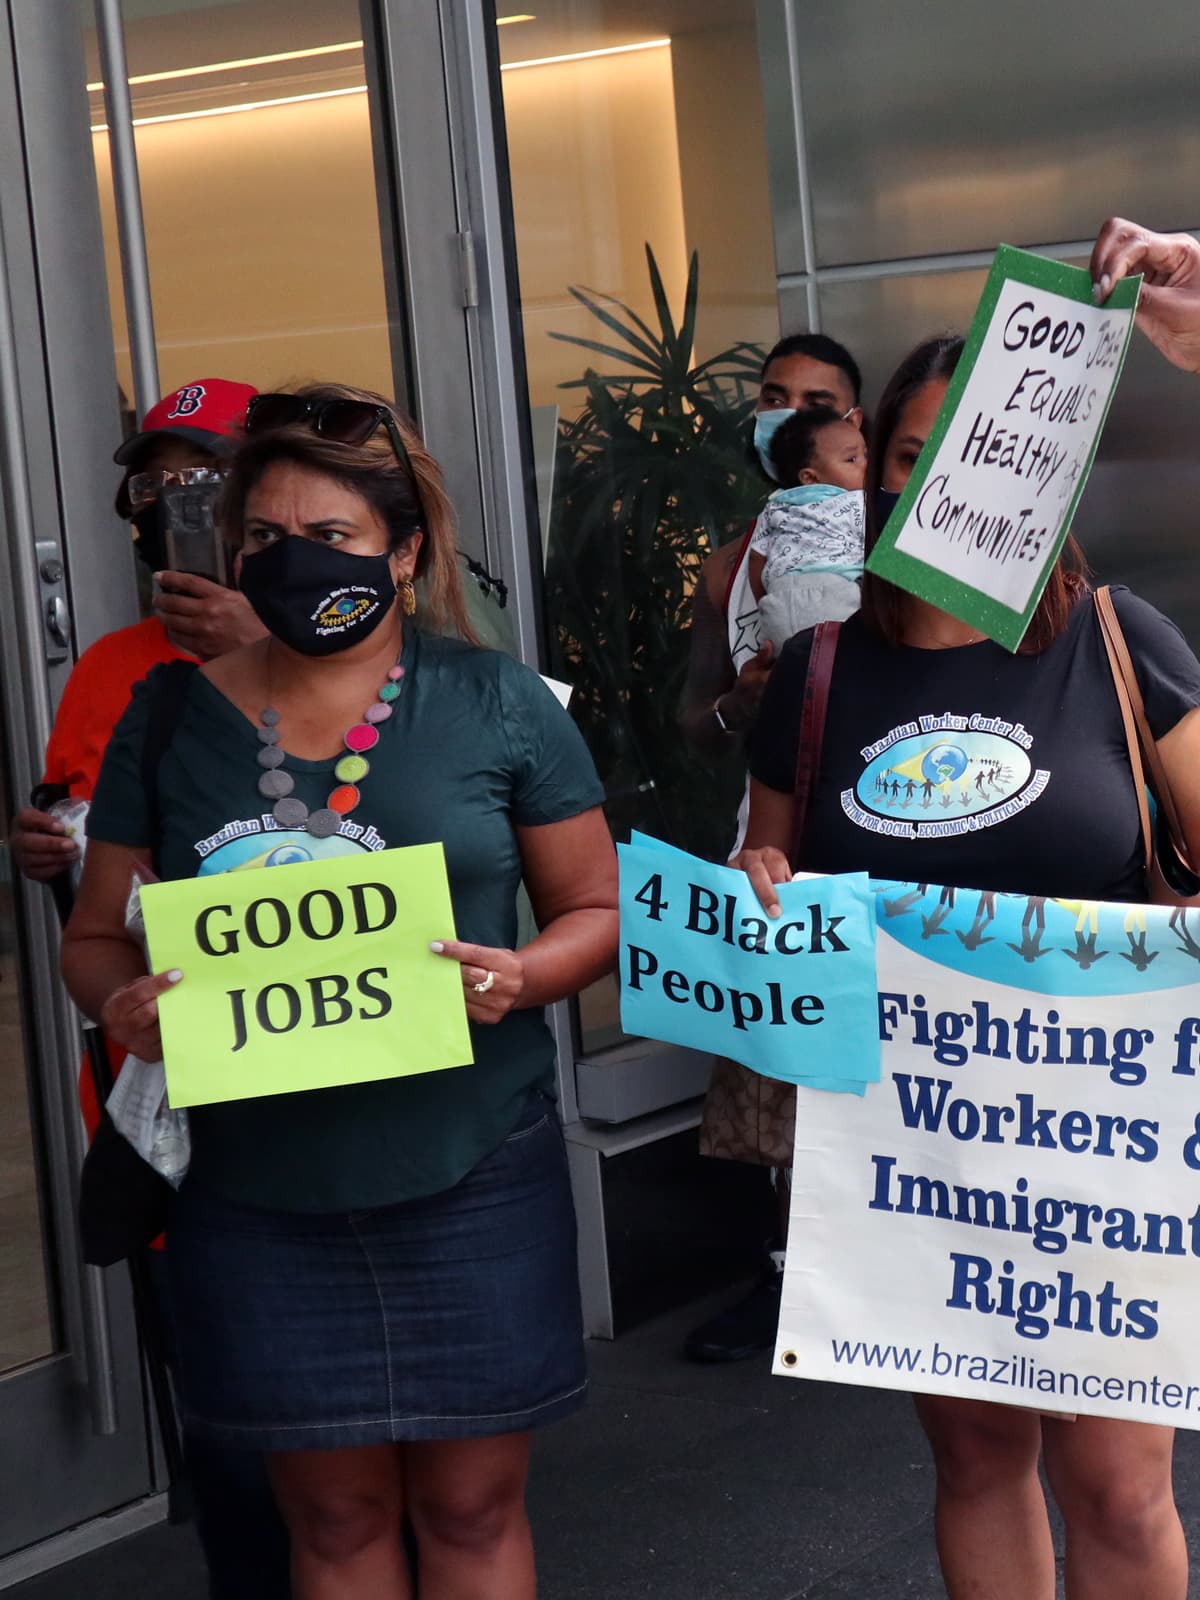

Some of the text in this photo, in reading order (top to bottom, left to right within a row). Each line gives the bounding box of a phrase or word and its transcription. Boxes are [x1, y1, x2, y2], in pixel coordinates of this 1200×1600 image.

[1003, 301, 1125, 369] GOOD JO
[168, 385, 206, 418] B
[1004, 368, 1097, 425] EQUALS
[860, 712, 1033, 762] Brazilian Worker Center Inc.
[195, 819, 260, 856] Brazilian
[862, 816, 880, 834] FOR
[878, 820, 917, 840] SOCIAL,
[917, 819, 969, 838] ECONOMIC
[967, 817, 977, 831] &
[976, 801, 1024, 829] POLITICAL
[1021, 769, 1051, 808] JUSTICE
[195, 882, 397, 956] GOOD
[633, 872, 851, 955] 4 Black
[227, 967, 392, 1052] JOBS
[627, 944, 825, 1030] People
[878, 992, 1155, 1087] Fighting
[892, 1073, 1160, 1163] Workers
[946, 1253, 1160, 1340] Rights
